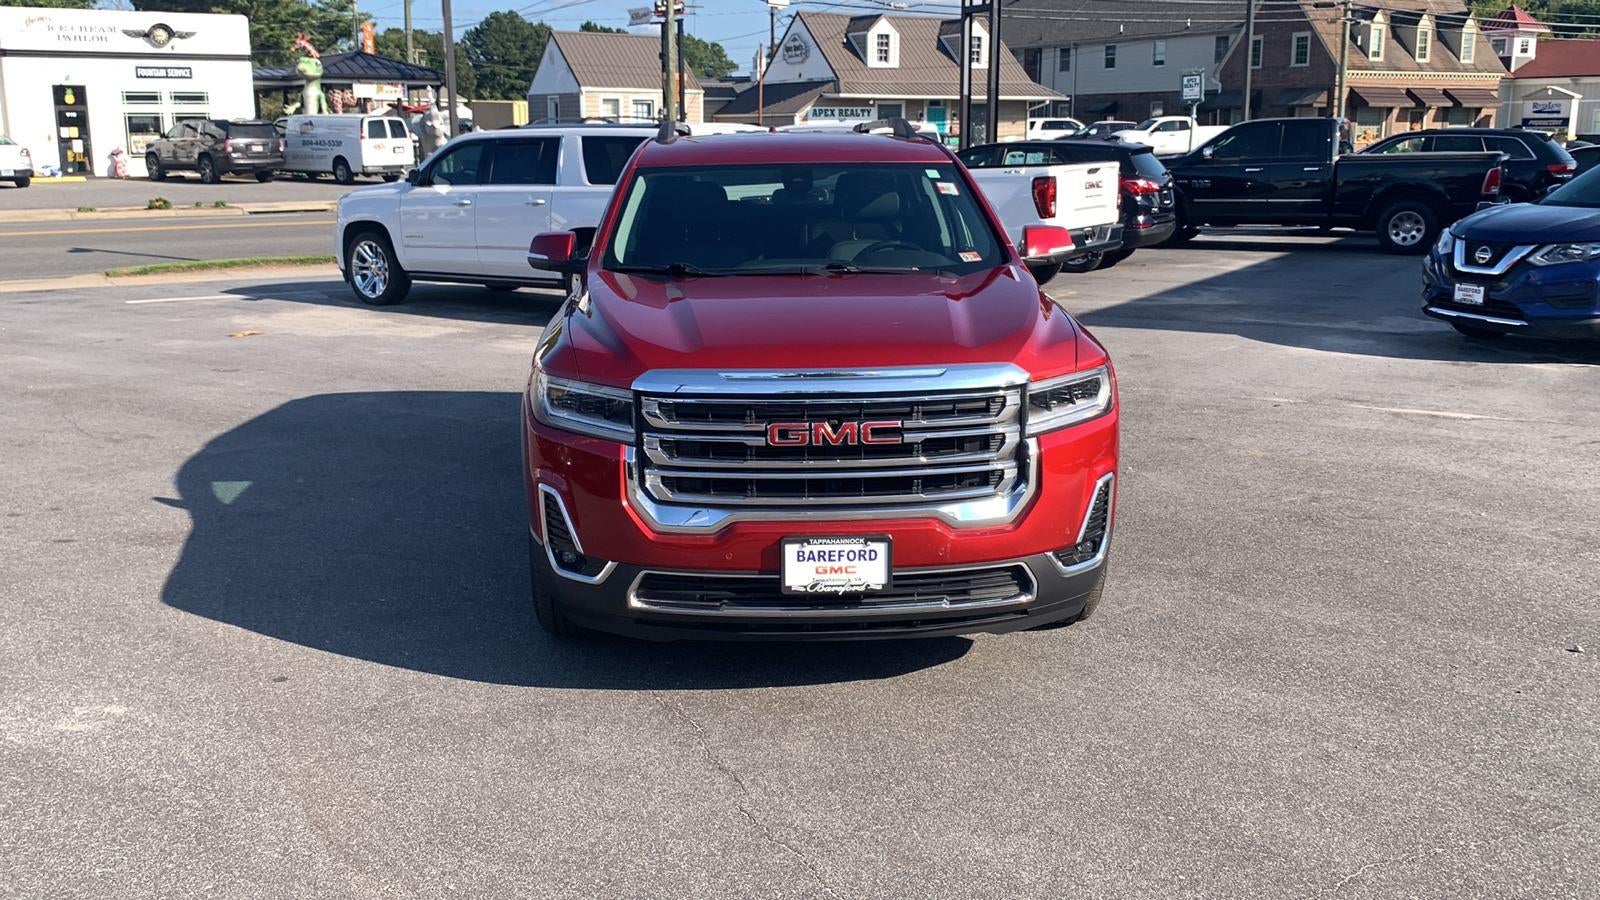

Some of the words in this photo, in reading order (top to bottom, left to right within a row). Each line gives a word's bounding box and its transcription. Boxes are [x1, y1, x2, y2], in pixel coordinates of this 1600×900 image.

[70, 25, 116, 33] CREAM
[56, 34, 108, 42] PARLOR
[137, 68, 166, 77] FOUNTAIN
[167, 69, 191, 77] SERVICE
[812, 108, 835, 117] APEX
[838, 108, 872, 117] REALTY
[1084, 181, 1103, 190] GMC
[766, 420, 903, 447] GMC
[796, 549, 878, 562] BAREFORD
[815, 565, 857, 574] GMC
[807, 580, 867, 596] Bareford
